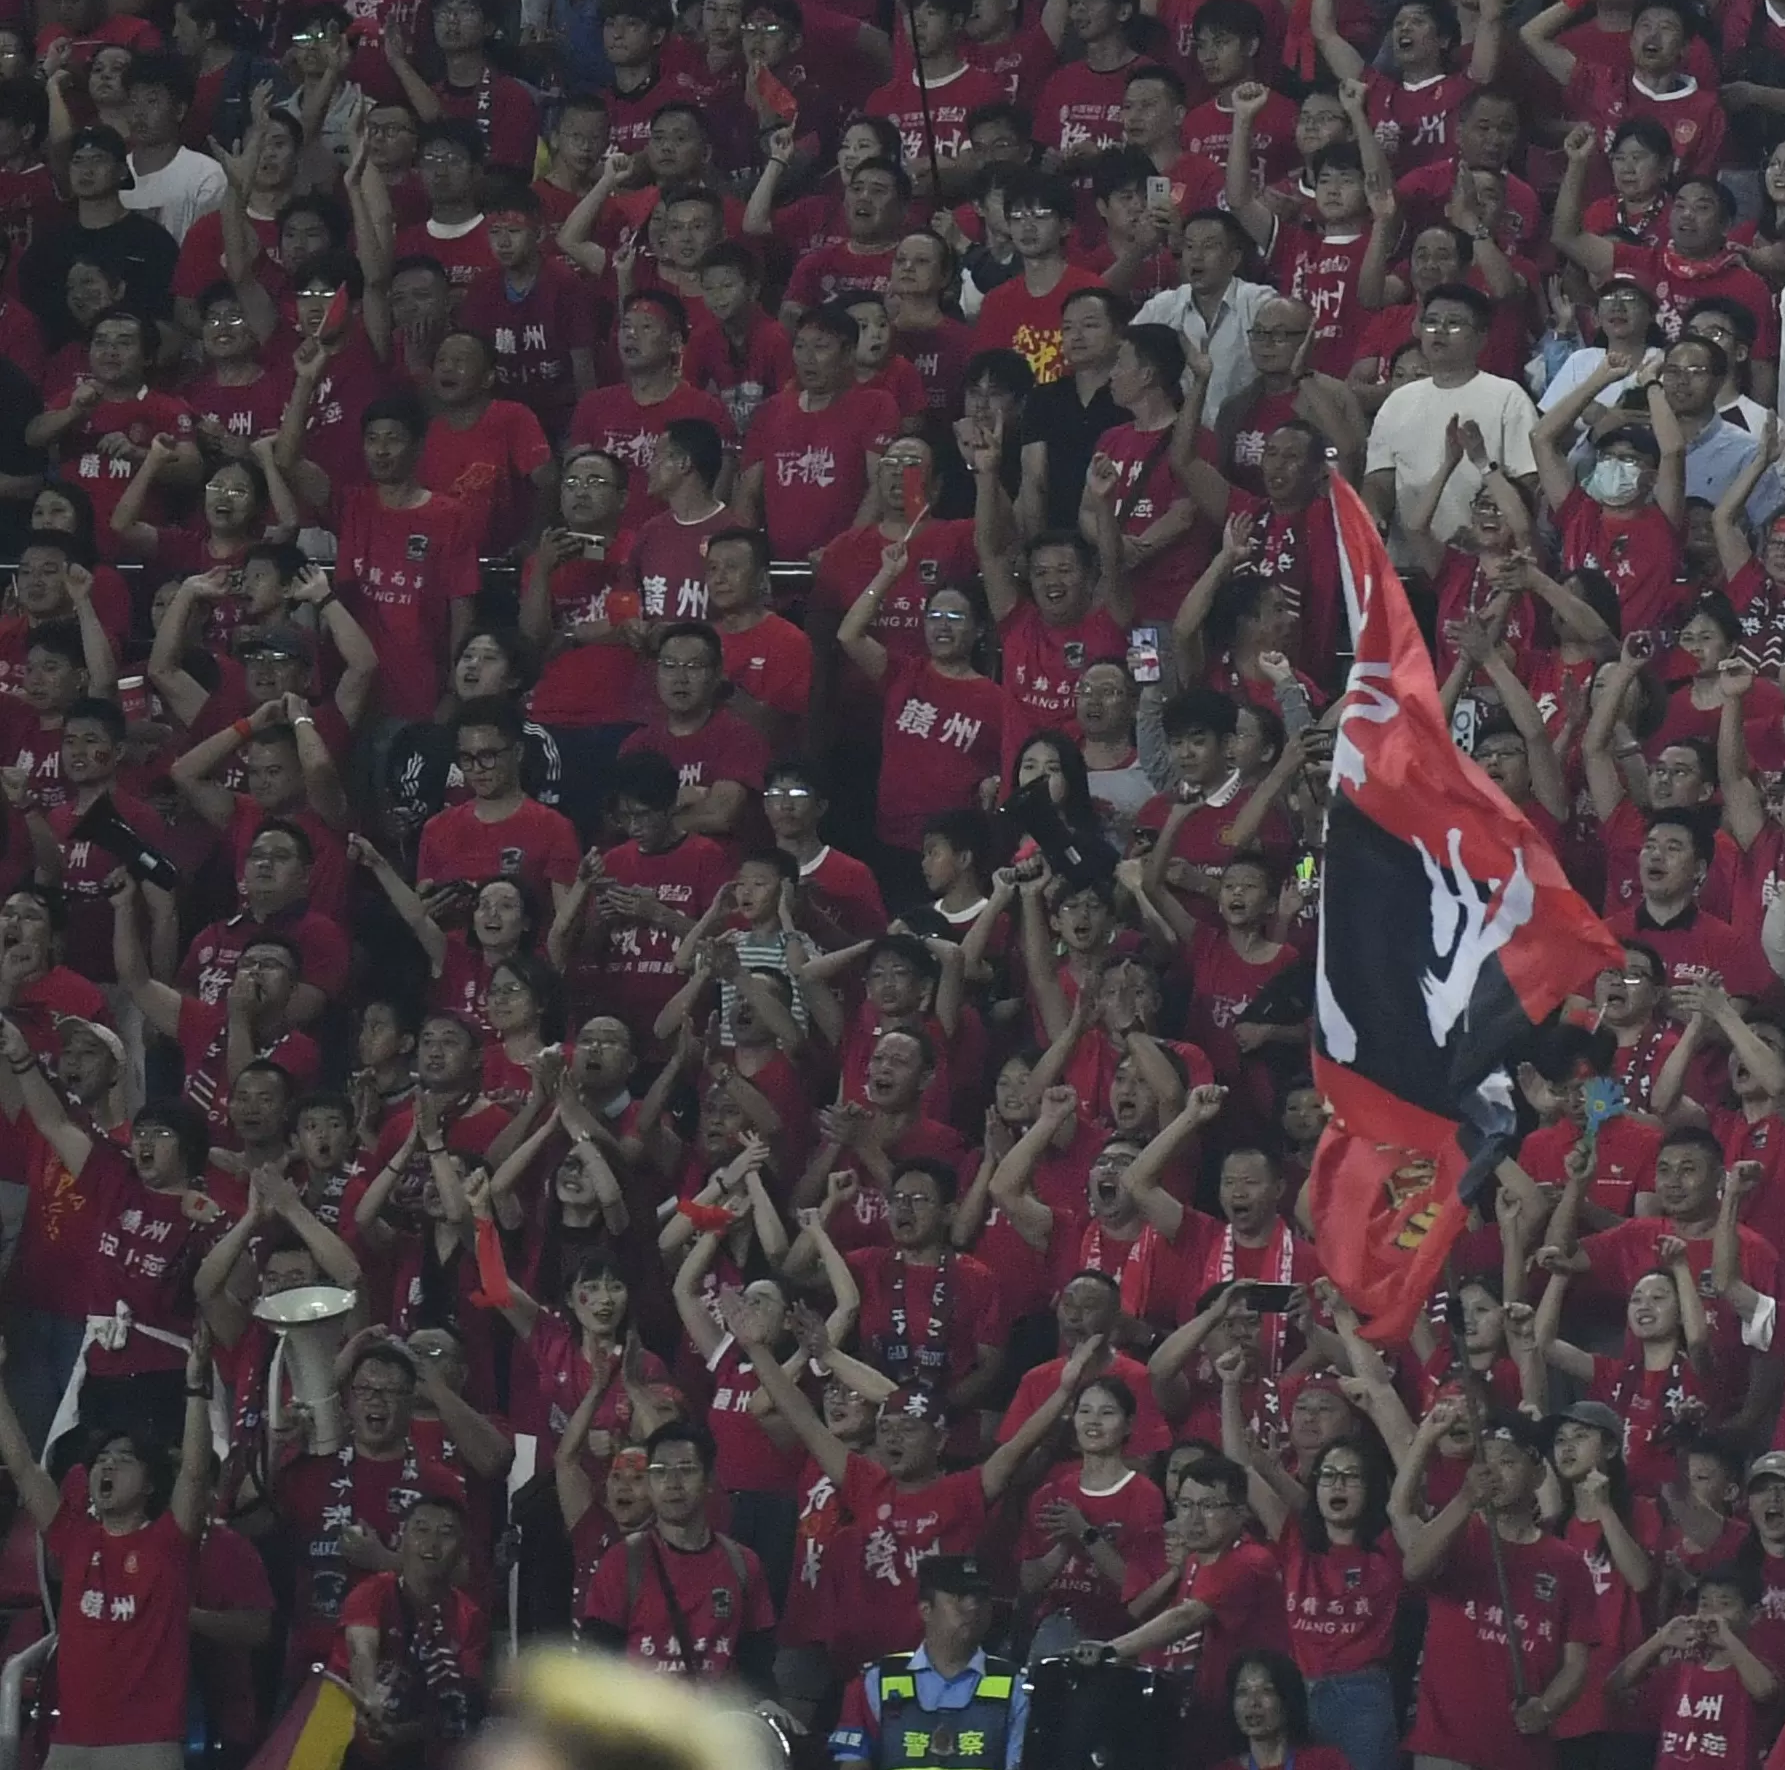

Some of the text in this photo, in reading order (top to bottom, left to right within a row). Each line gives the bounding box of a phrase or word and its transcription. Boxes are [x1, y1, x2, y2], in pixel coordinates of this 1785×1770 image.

[643, 576, 709, 619] 赣州
[896, 699, 981, 754] 赣州
[679, 761, 702, 785] 州
[58, 841, 90, 868] 州
[81, 1589, 135, 1621] 赣州
[1293, 1619, 1356, 1634] JIANG XI
[1478, 1627, 1512, 1644] JIAN
[904, 1730, 985, 1758] 警察
